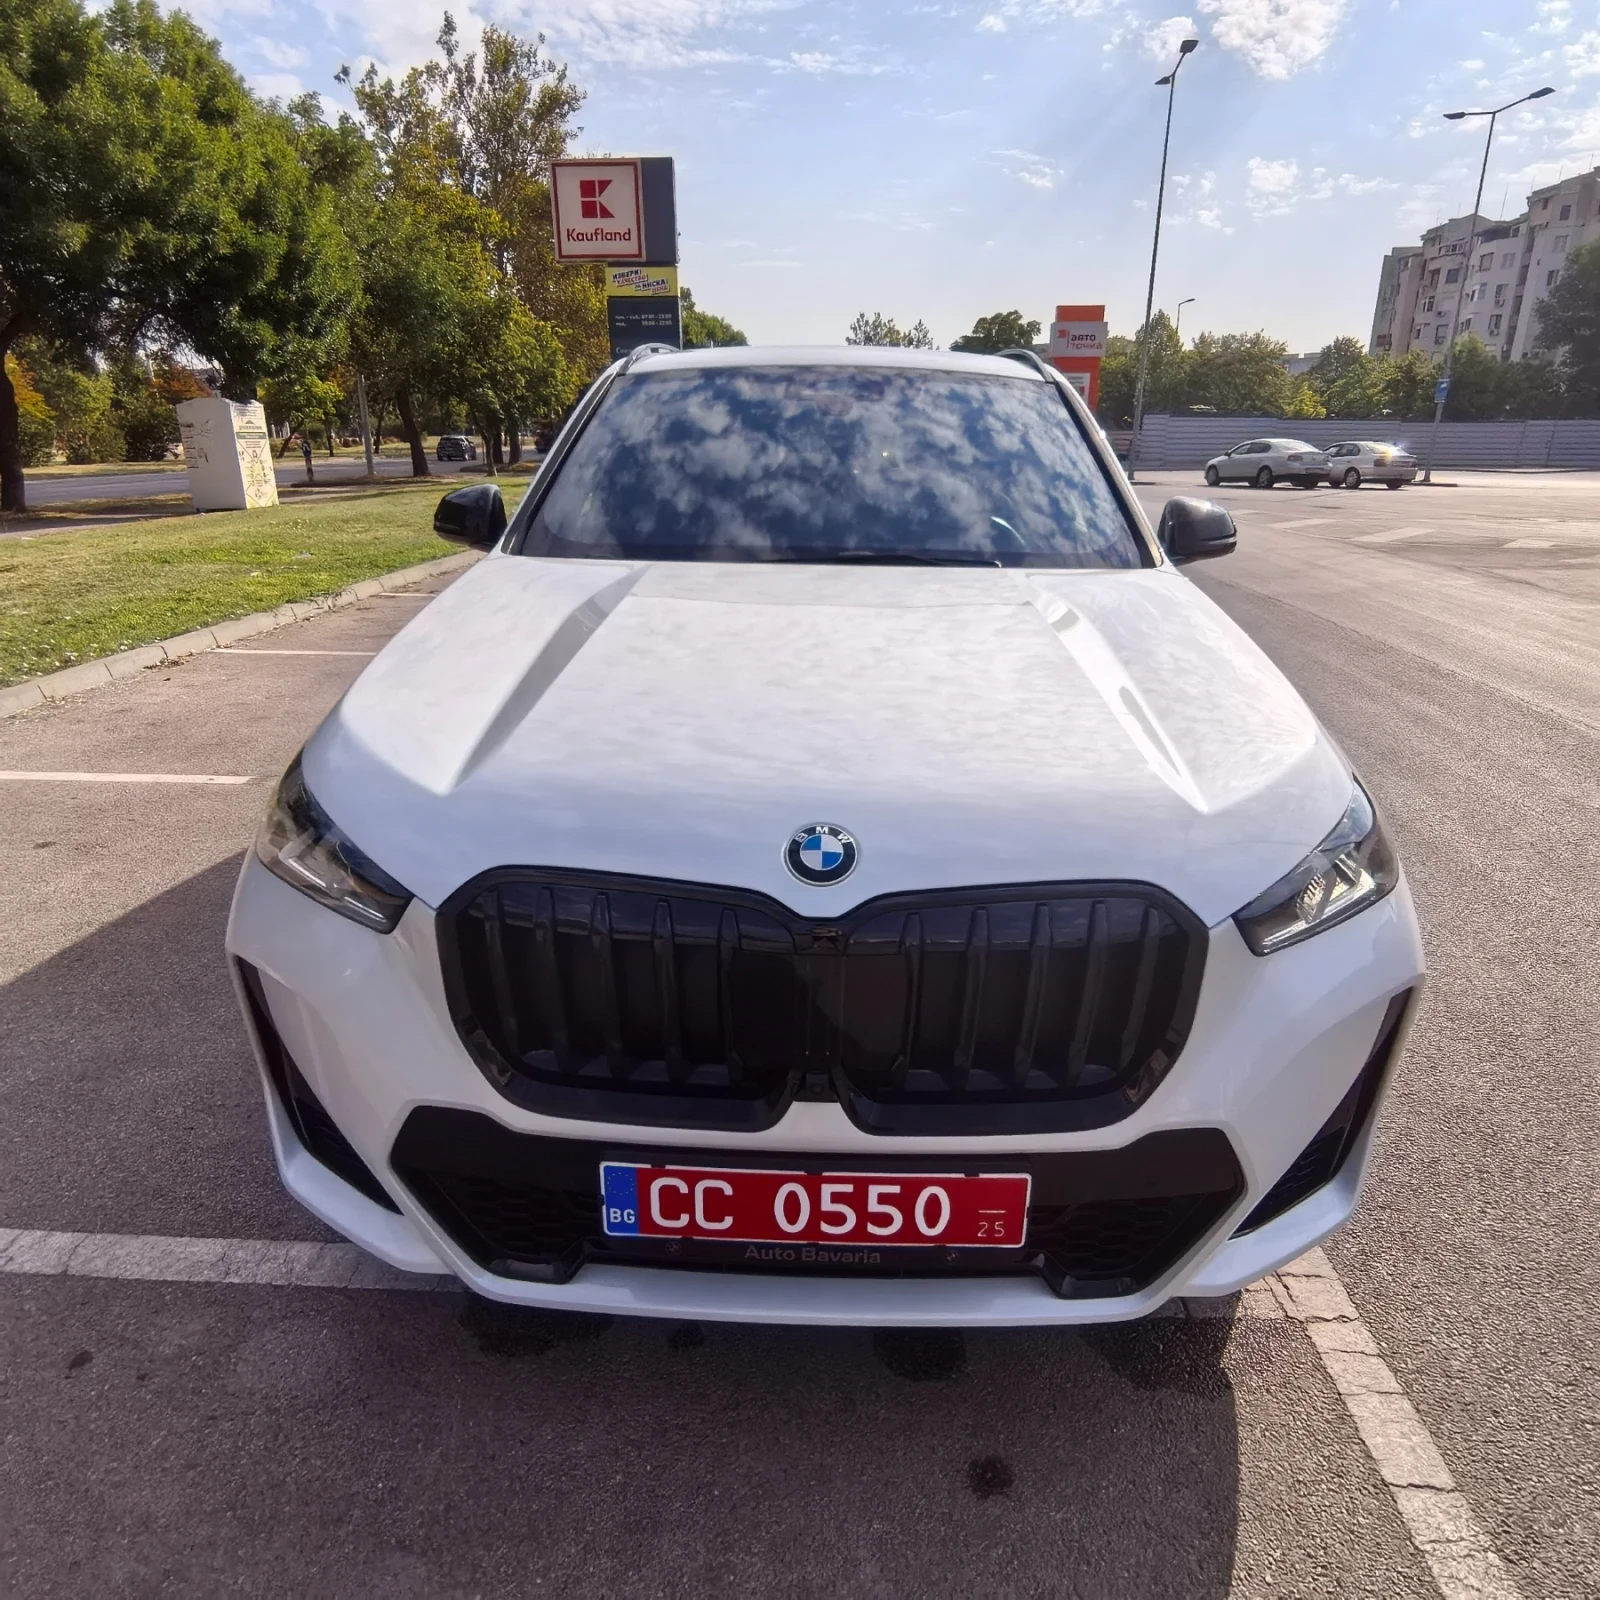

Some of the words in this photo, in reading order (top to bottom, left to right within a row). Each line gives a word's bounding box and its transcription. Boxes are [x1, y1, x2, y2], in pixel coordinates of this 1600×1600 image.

[566, 228, 631, 242] Kaufland
[794, 826, 853, 843] BMW
[650, 1177, 733, 1230] CC
[774, 1182, 951, 1236] 0550
[609, 1208, 636, 1223] BG
[976, 1221, 1005, 1237] 25
[744, 1245, 796, 1261] Auto
[801, 1247, 881, 1264] Bavaria
